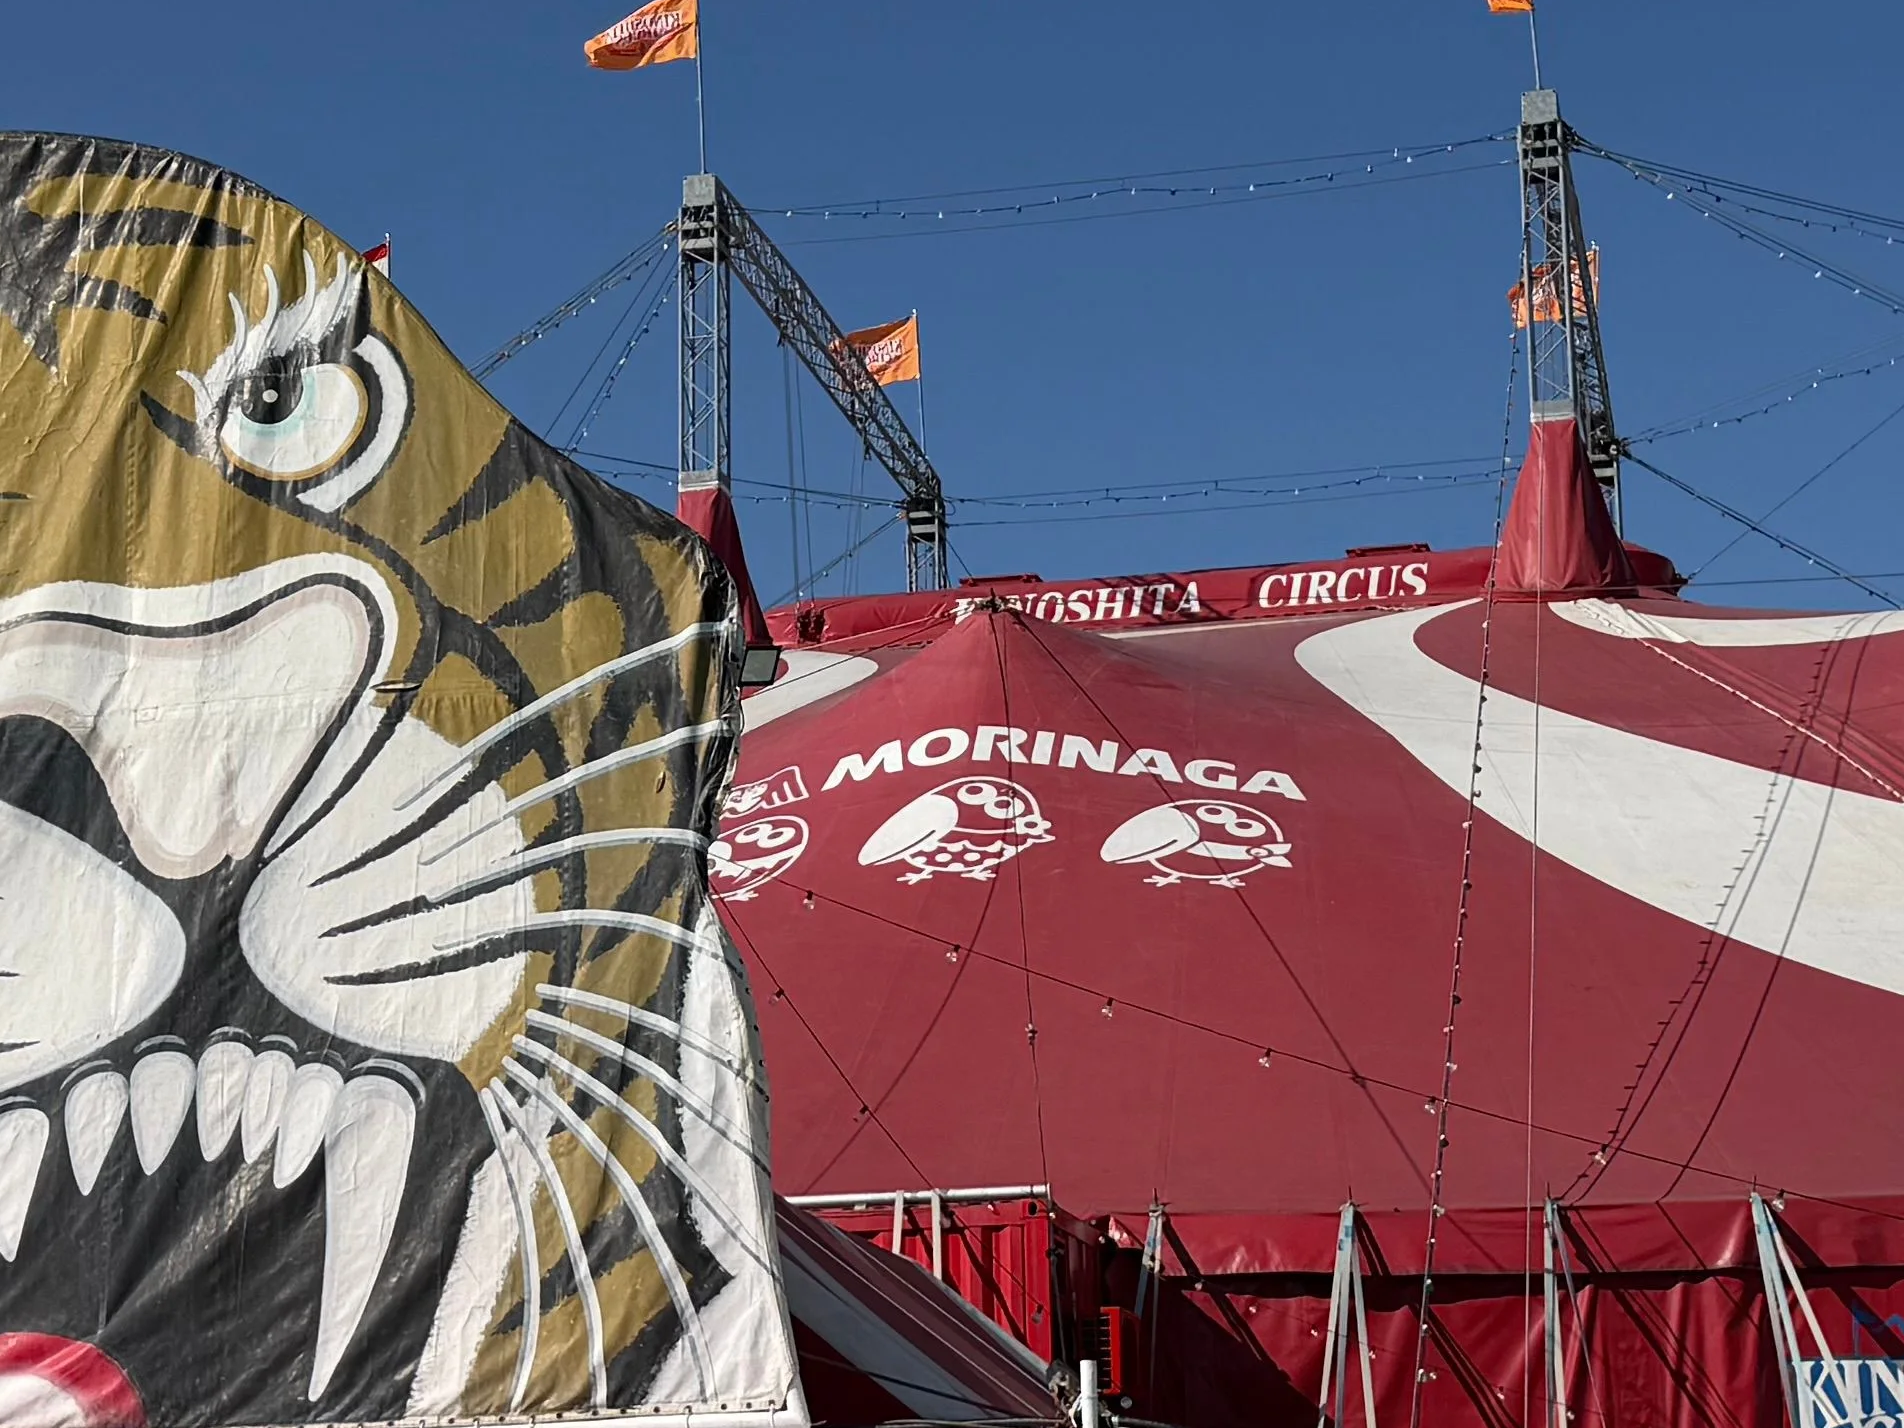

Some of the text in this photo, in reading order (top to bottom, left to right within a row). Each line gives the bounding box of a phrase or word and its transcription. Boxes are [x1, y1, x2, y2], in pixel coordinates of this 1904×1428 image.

[953, 563, 1429, 625] KNOSHITA CIRCUS
[822, 725, 1307, 802] MORINAGA
